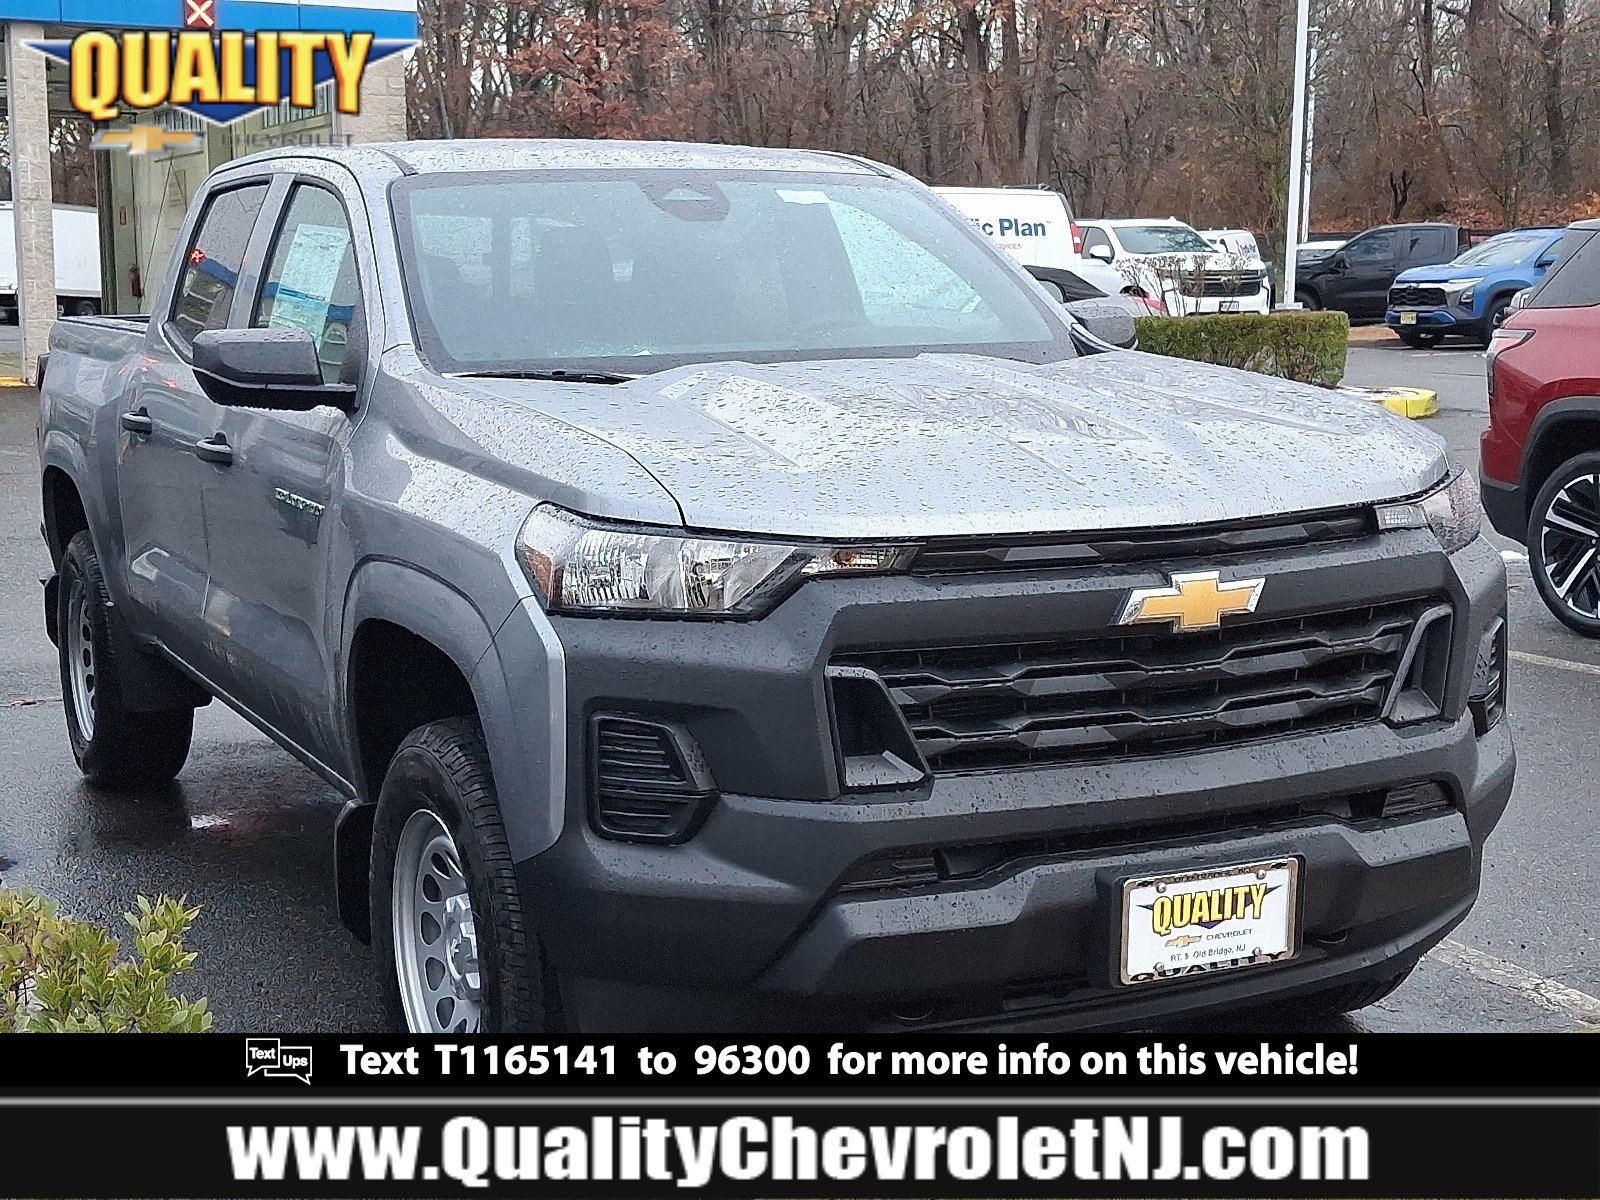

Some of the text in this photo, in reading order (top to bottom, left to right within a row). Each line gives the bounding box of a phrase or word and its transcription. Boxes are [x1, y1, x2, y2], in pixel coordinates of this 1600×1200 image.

[999, 218, 1046, 237] Plan
[1152, 883, 1267, 937] QUALITY
[1206, 928, 1253, 941] CHEVROLET
[1193, 950, 1207, 959] Old
[1236, 943, 1246, 952] NJ
